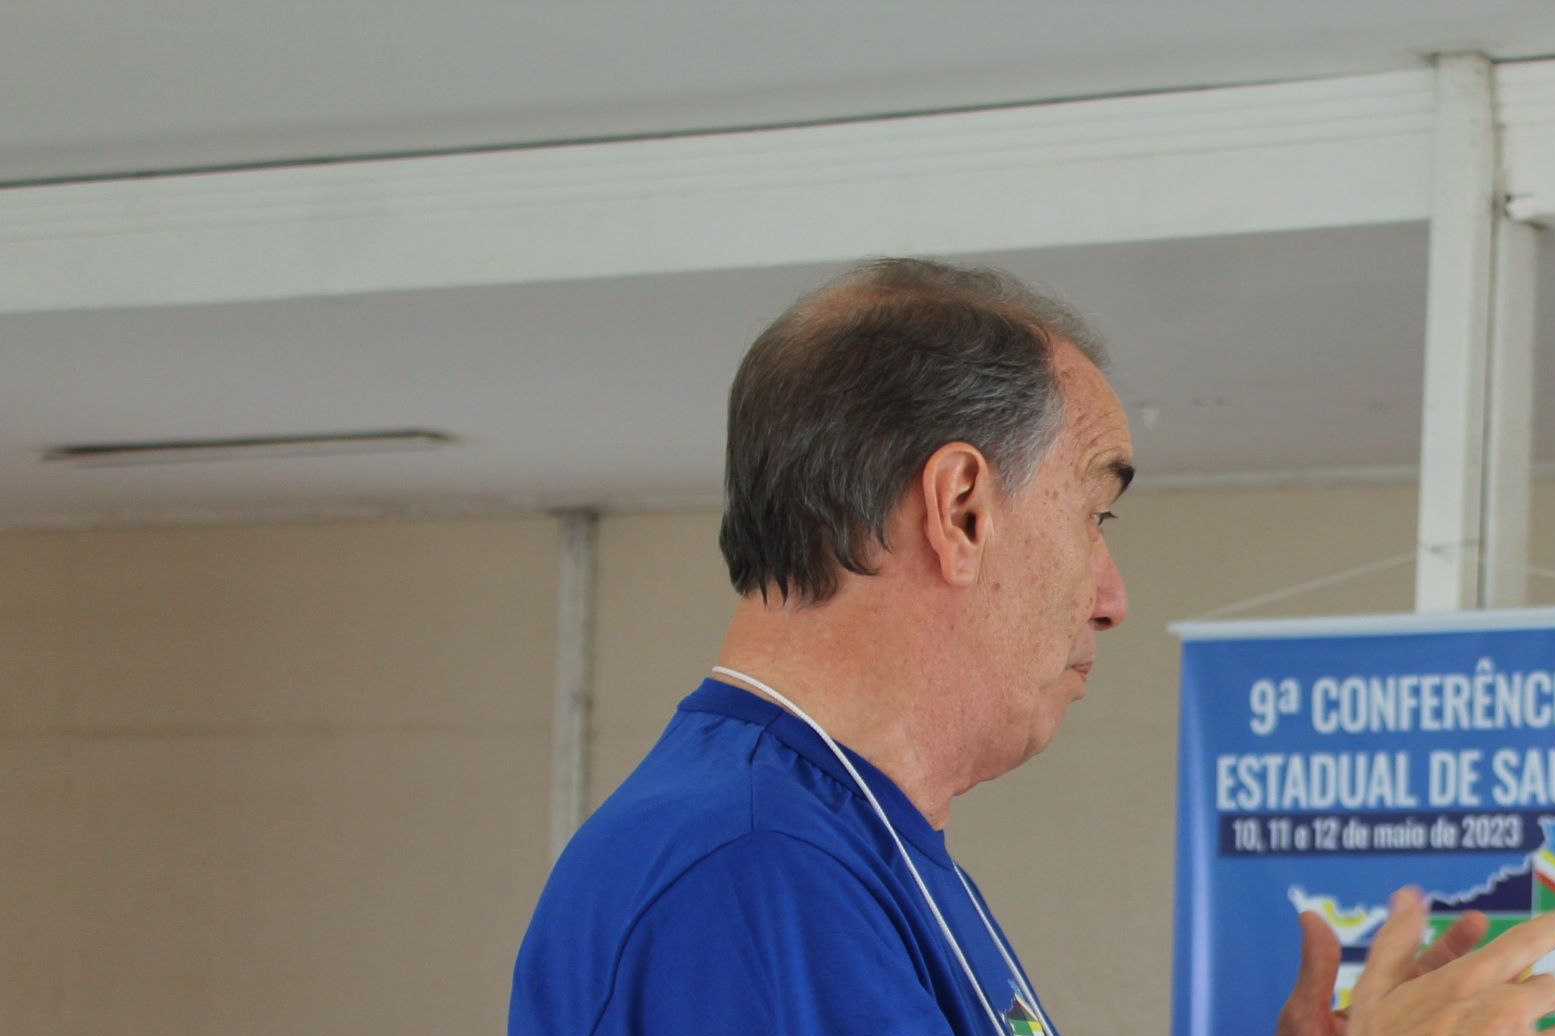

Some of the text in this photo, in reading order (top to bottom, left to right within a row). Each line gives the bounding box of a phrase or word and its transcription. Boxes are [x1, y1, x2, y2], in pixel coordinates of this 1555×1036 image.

[1217, 751, 1417, 810] ESTADUAL
[1429, 749, 1482, 807] DE
[1233, 814, 1522, 852] 10, 11 e 12 de maio de 2023
